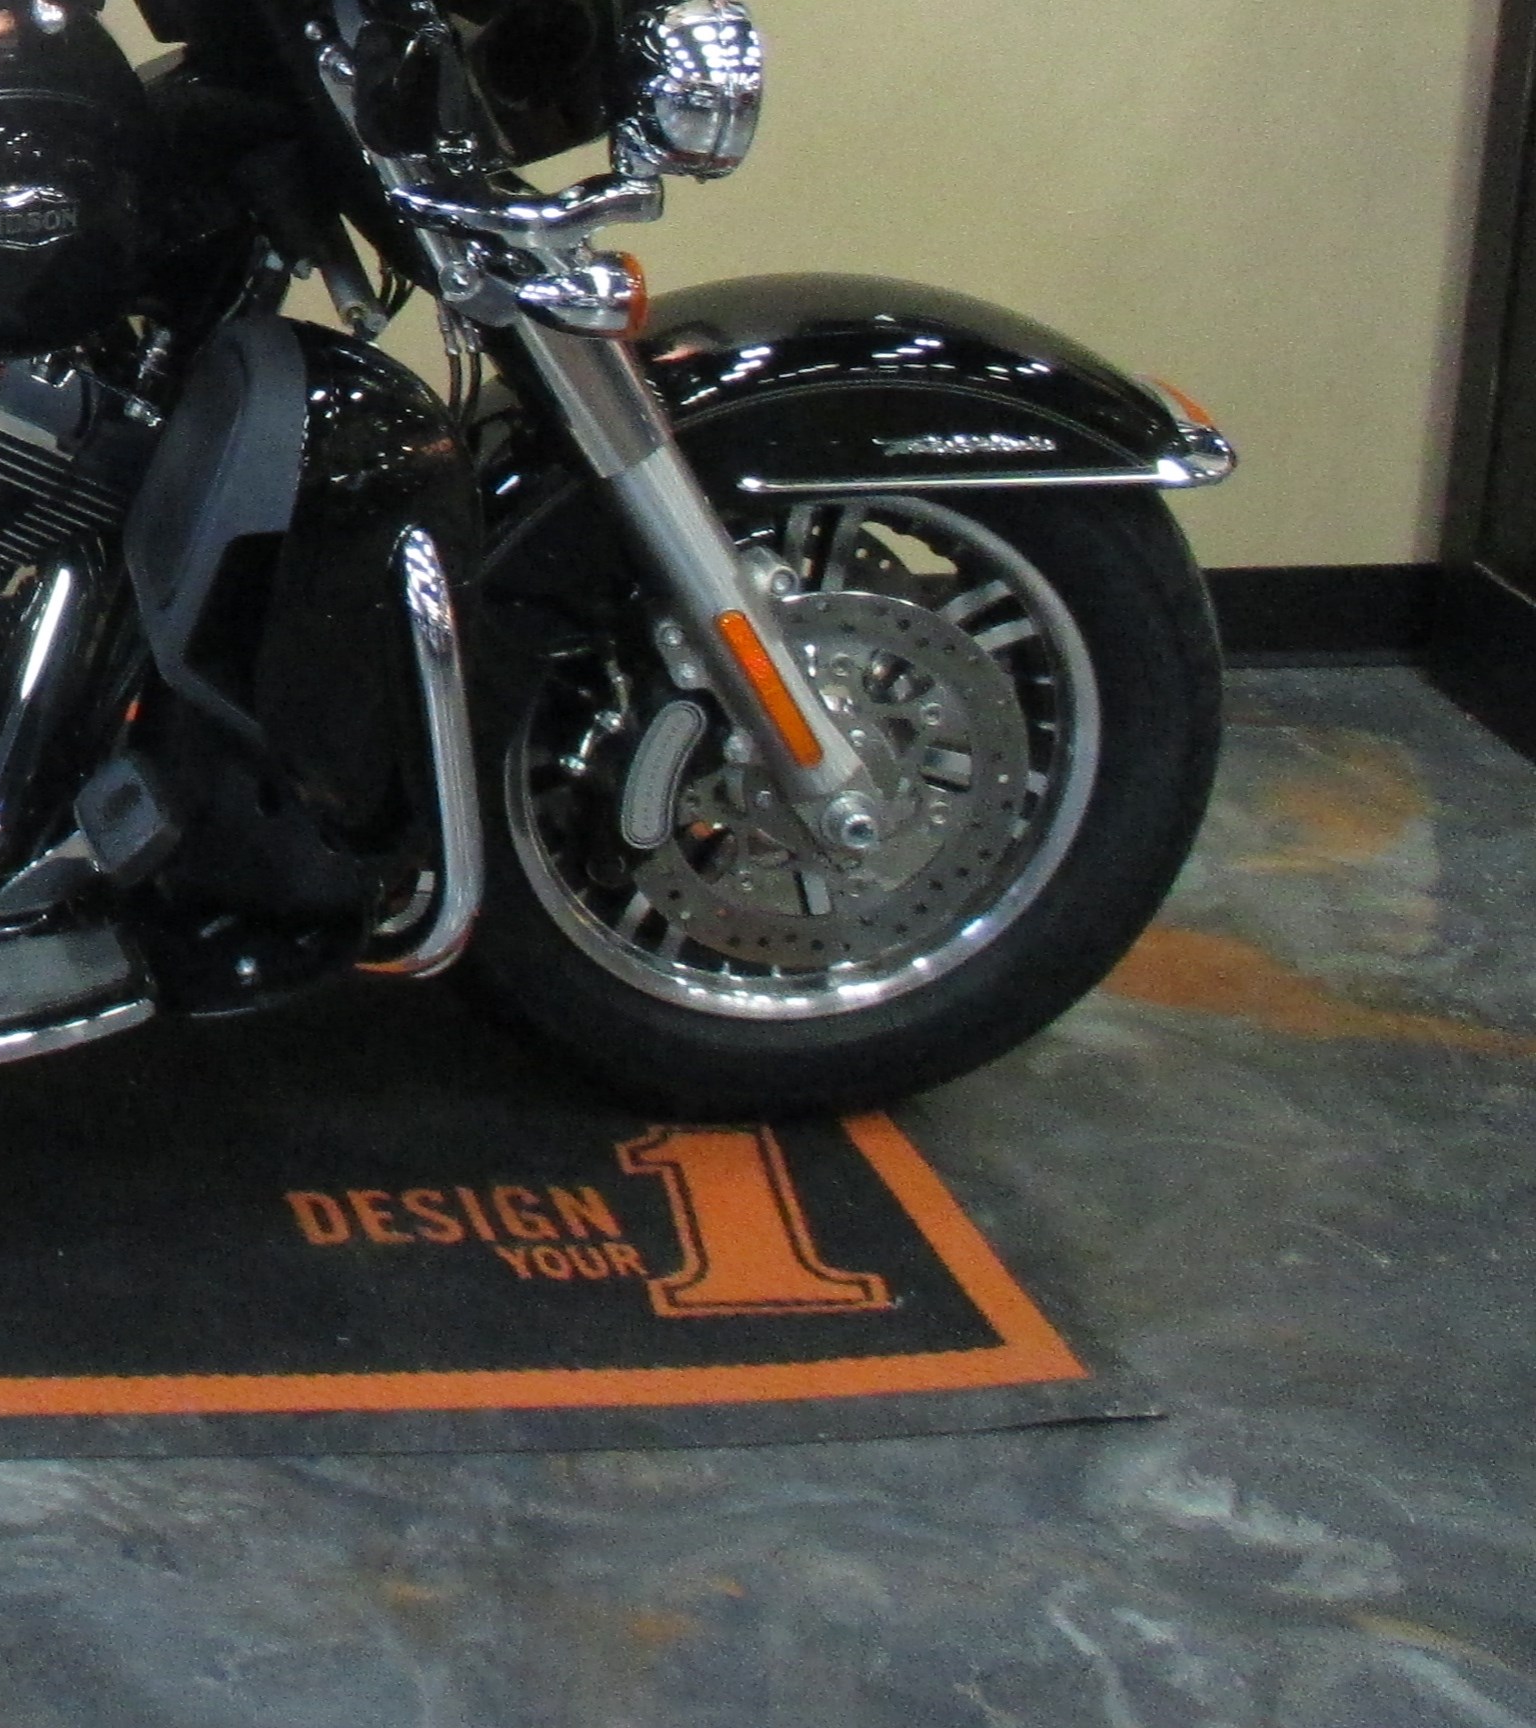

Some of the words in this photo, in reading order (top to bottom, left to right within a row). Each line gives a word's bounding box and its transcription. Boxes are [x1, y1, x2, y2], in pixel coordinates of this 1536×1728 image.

[285, 1186, 623, 1245] DESIGN
[616, 1123, 892, 1317] 1
[494, 1243, 648, 1279] YOUR
